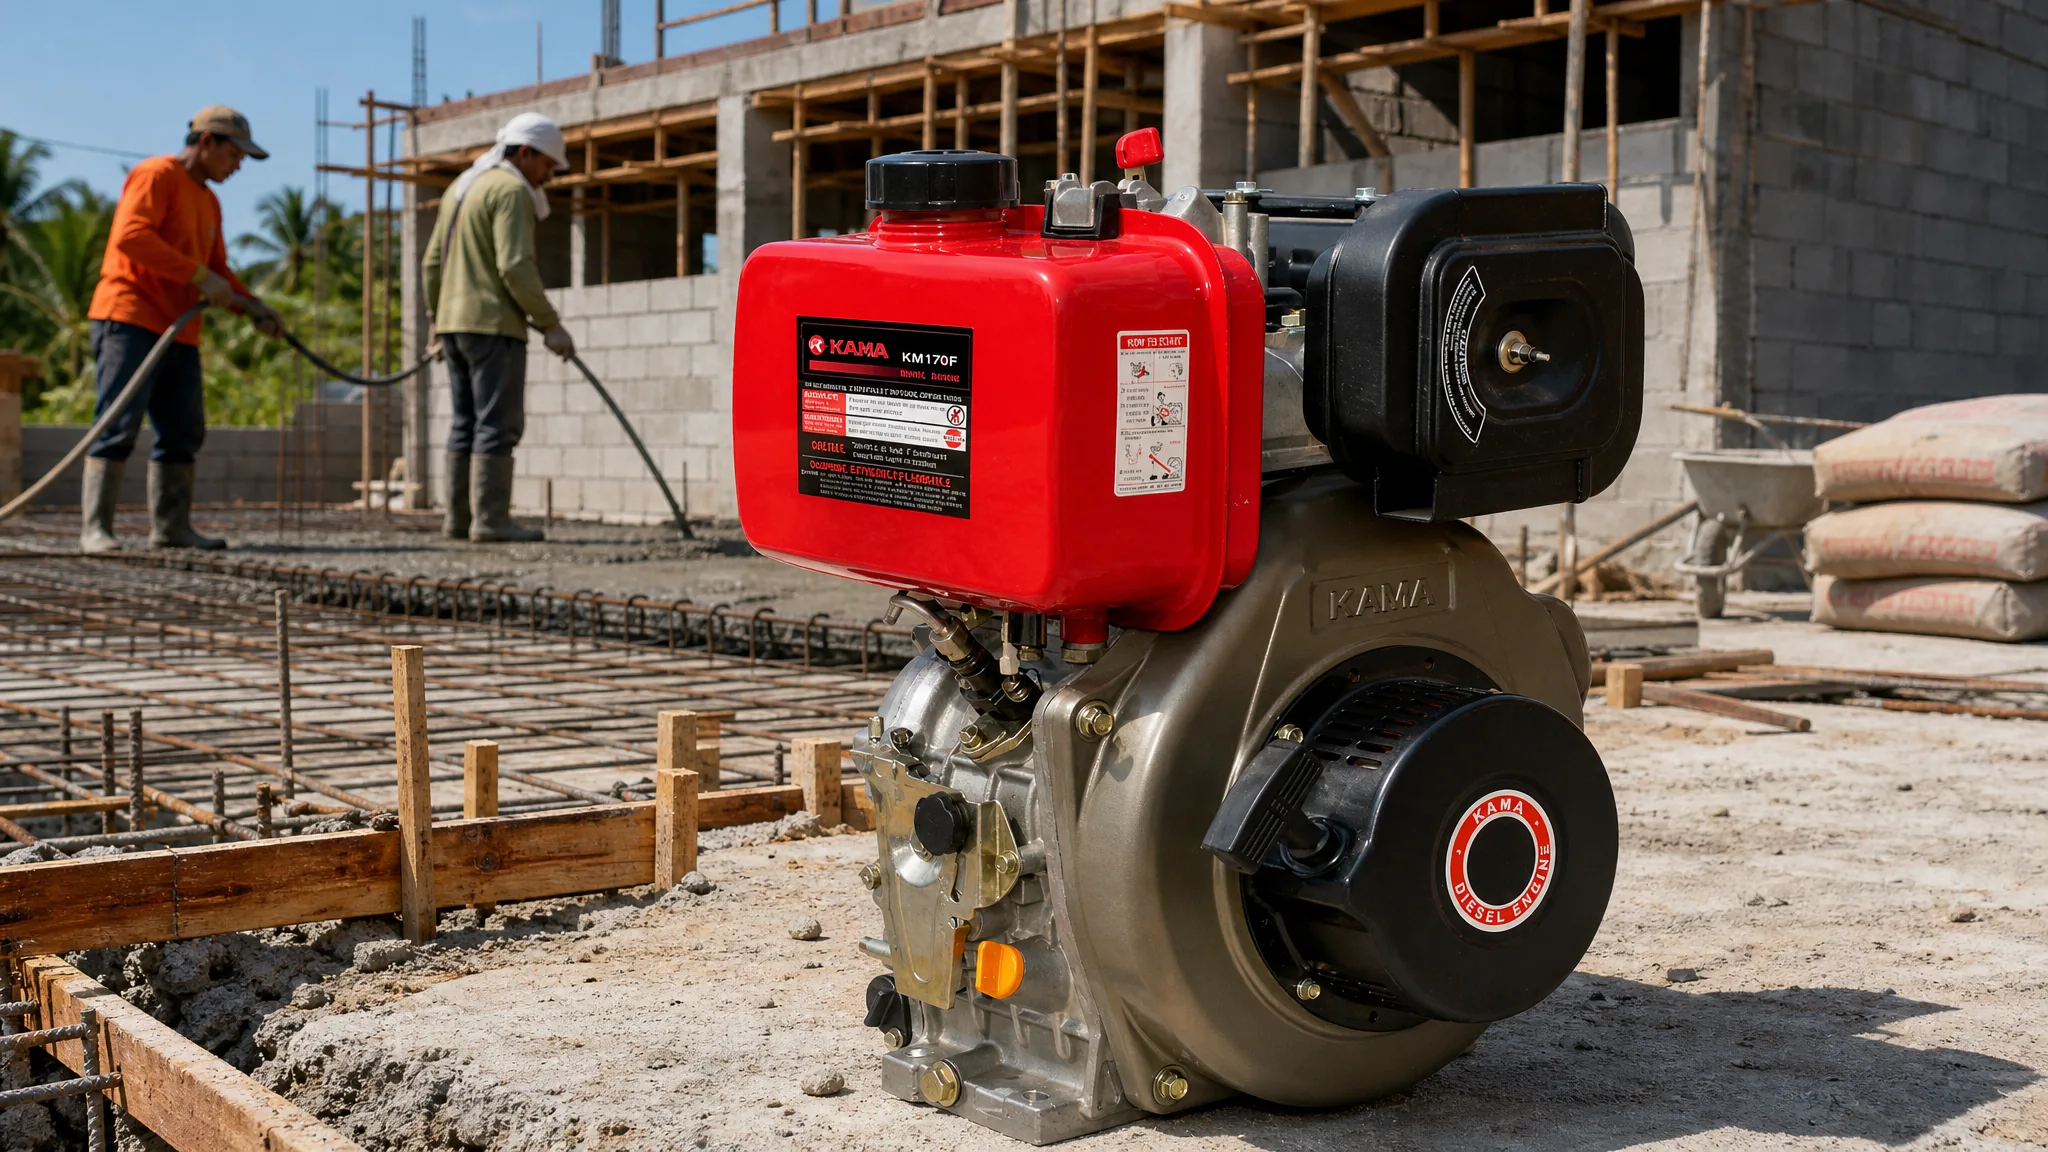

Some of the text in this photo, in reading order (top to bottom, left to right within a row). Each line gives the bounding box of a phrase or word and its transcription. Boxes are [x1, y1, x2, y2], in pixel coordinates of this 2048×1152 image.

[830, 339, 889, 359] KAMA
[902, 352, 958, 367] KM170F
[1329, 578, 1435, 620] KAMA
[1472, 798, 1523, 824] KAMA
[1455, 882, 1505, 923] DIESEL
